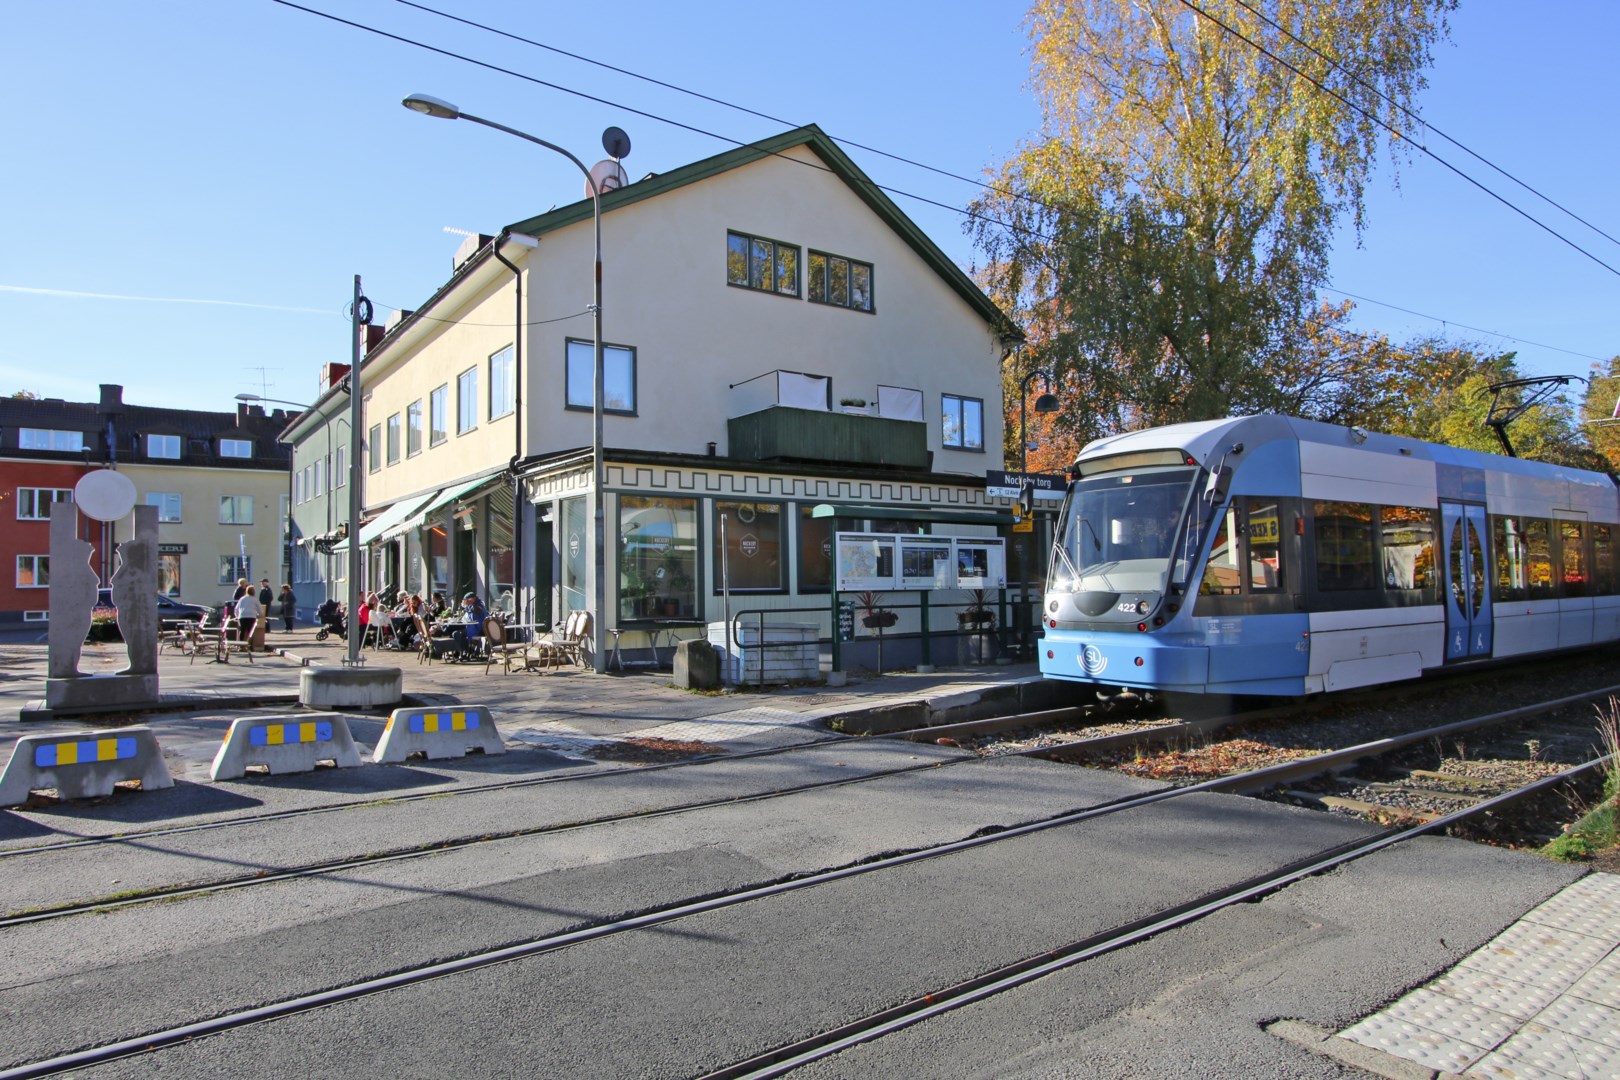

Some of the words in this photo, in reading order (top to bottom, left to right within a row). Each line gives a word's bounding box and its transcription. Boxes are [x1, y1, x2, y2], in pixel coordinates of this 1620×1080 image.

[1037, 477, 1052, 489] torg
[1117, 602, 1137, 613] 422
[1085, 650, 1099, 663] SL
